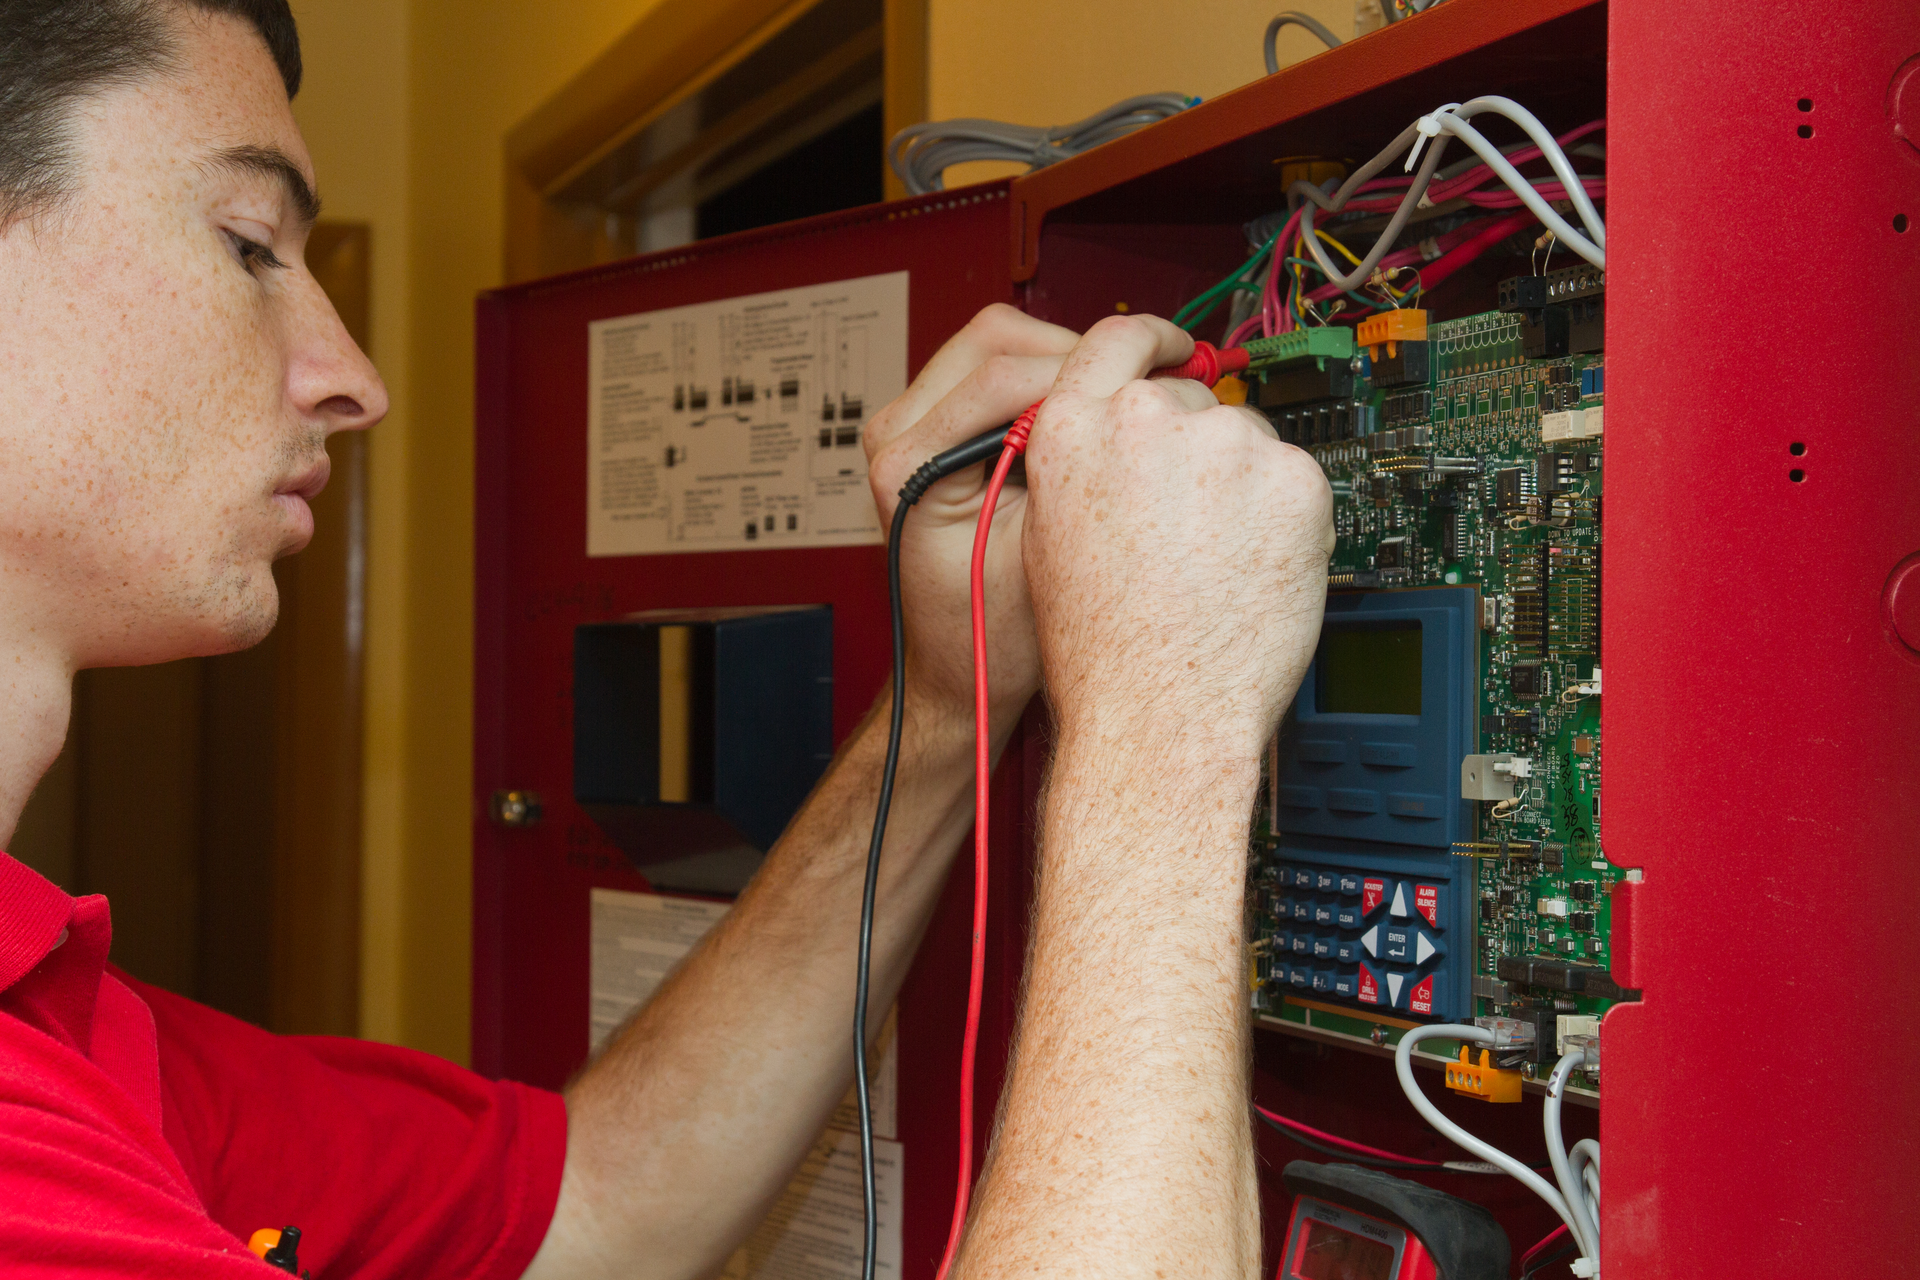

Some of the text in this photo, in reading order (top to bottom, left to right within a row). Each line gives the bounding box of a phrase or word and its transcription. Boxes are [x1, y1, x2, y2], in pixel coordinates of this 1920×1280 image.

[1572, 527, 1591, 536] UPDATE
[1419, 888, 1435, 897] ALARM
[1417, 898, 1436, 907] SILENCE
[1339, 914, 1354, 924] CLEAR
[1388, 932, 1406, 943] ENTER
[1340, 948, 1349, 957] ESC
[1336, 982, 1349, 992] MODE
[1362, 986, 1375, 995] DRILL
[1412, 1001, 1431, 1012] RESET
